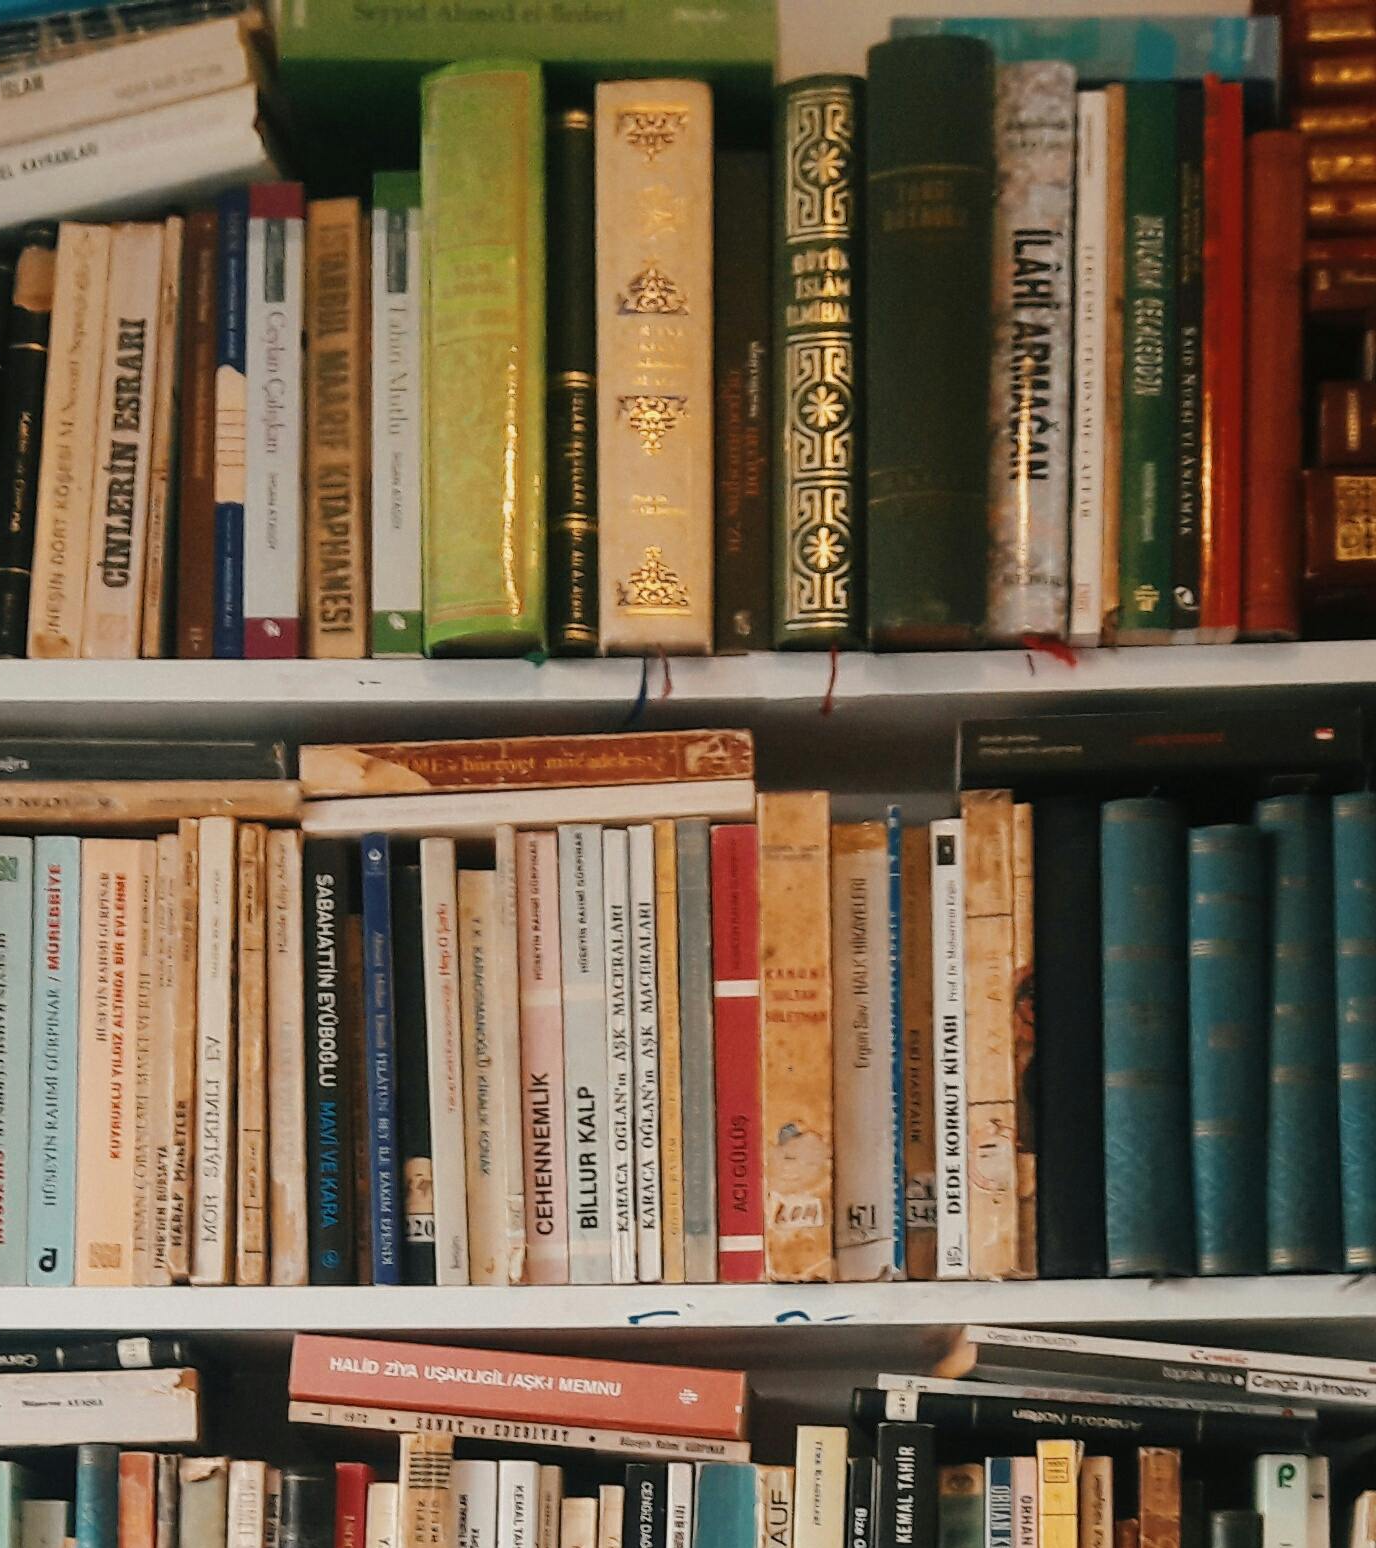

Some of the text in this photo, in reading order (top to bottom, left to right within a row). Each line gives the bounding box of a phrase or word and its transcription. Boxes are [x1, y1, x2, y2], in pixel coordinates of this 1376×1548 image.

[314, 873, 340, 1228] SABAHATTİN EYÜBOĞLU MAVİ VE KARA
[941, 1014, 962, 1215] DEDE KORKUT KİTABI
[529, 1072, 556, 1236] CEHENNEMLİK
[577, 1086, 599, 1229] BİLLUR KALP
[558, 1376, 622, 1397] MEMNU
[896, 1495, 915, 1544] KEMAL
[1021, 1495, 1036, 1545] ORHAN
